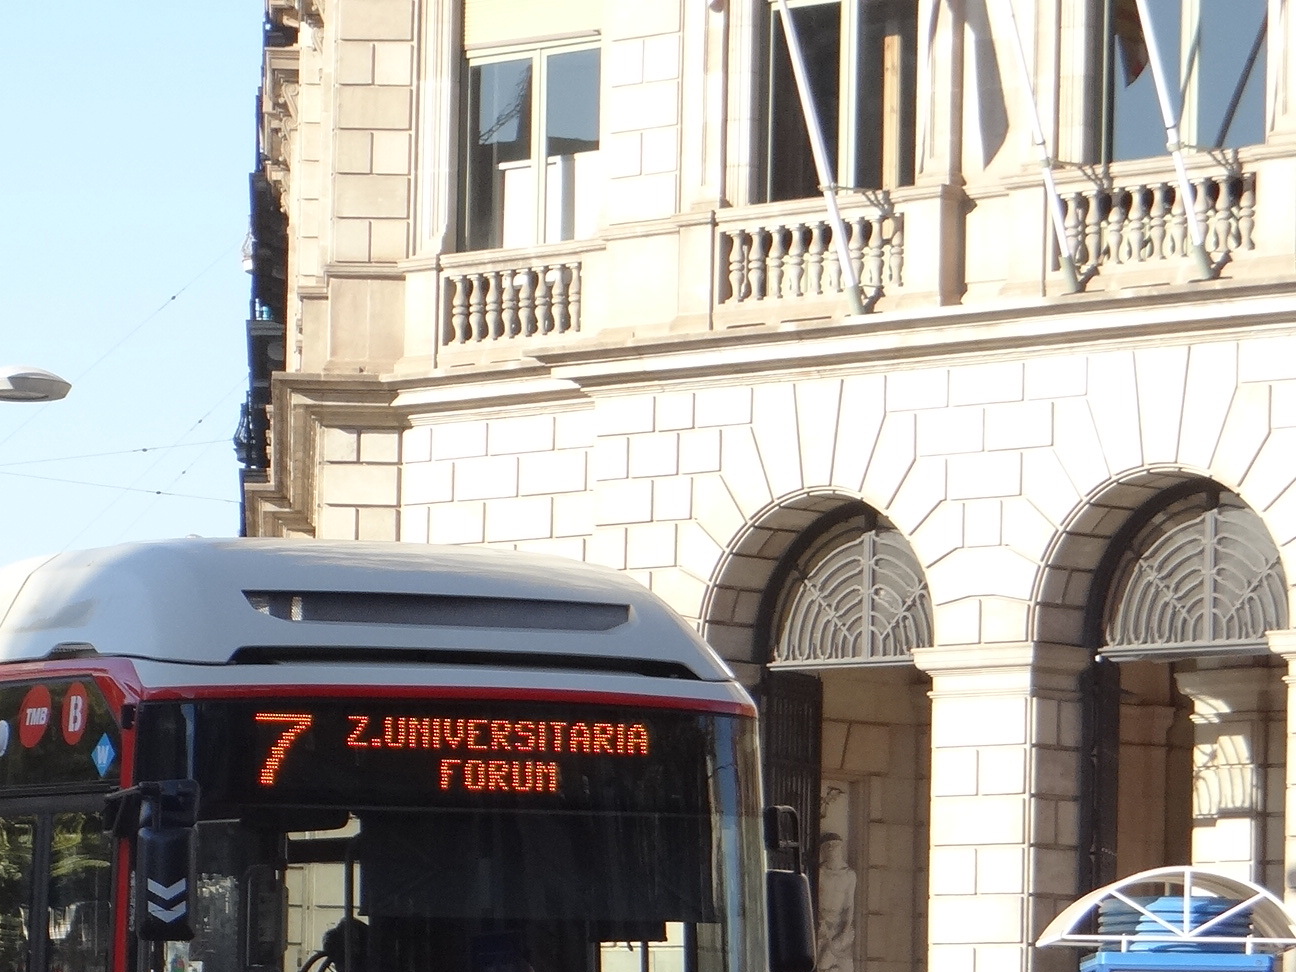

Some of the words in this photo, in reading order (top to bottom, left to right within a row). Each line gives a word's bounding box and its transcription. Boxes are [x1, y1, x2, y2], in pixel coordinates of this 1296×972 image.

[25, 707, 48, 726] TMB
[68, 695, 83, 732] B
[254, 712, 313, 786] 7
[347, 715, 648, 755] Z.UNIVERSITARIA
[439, 758, 558, 791] FORUM
